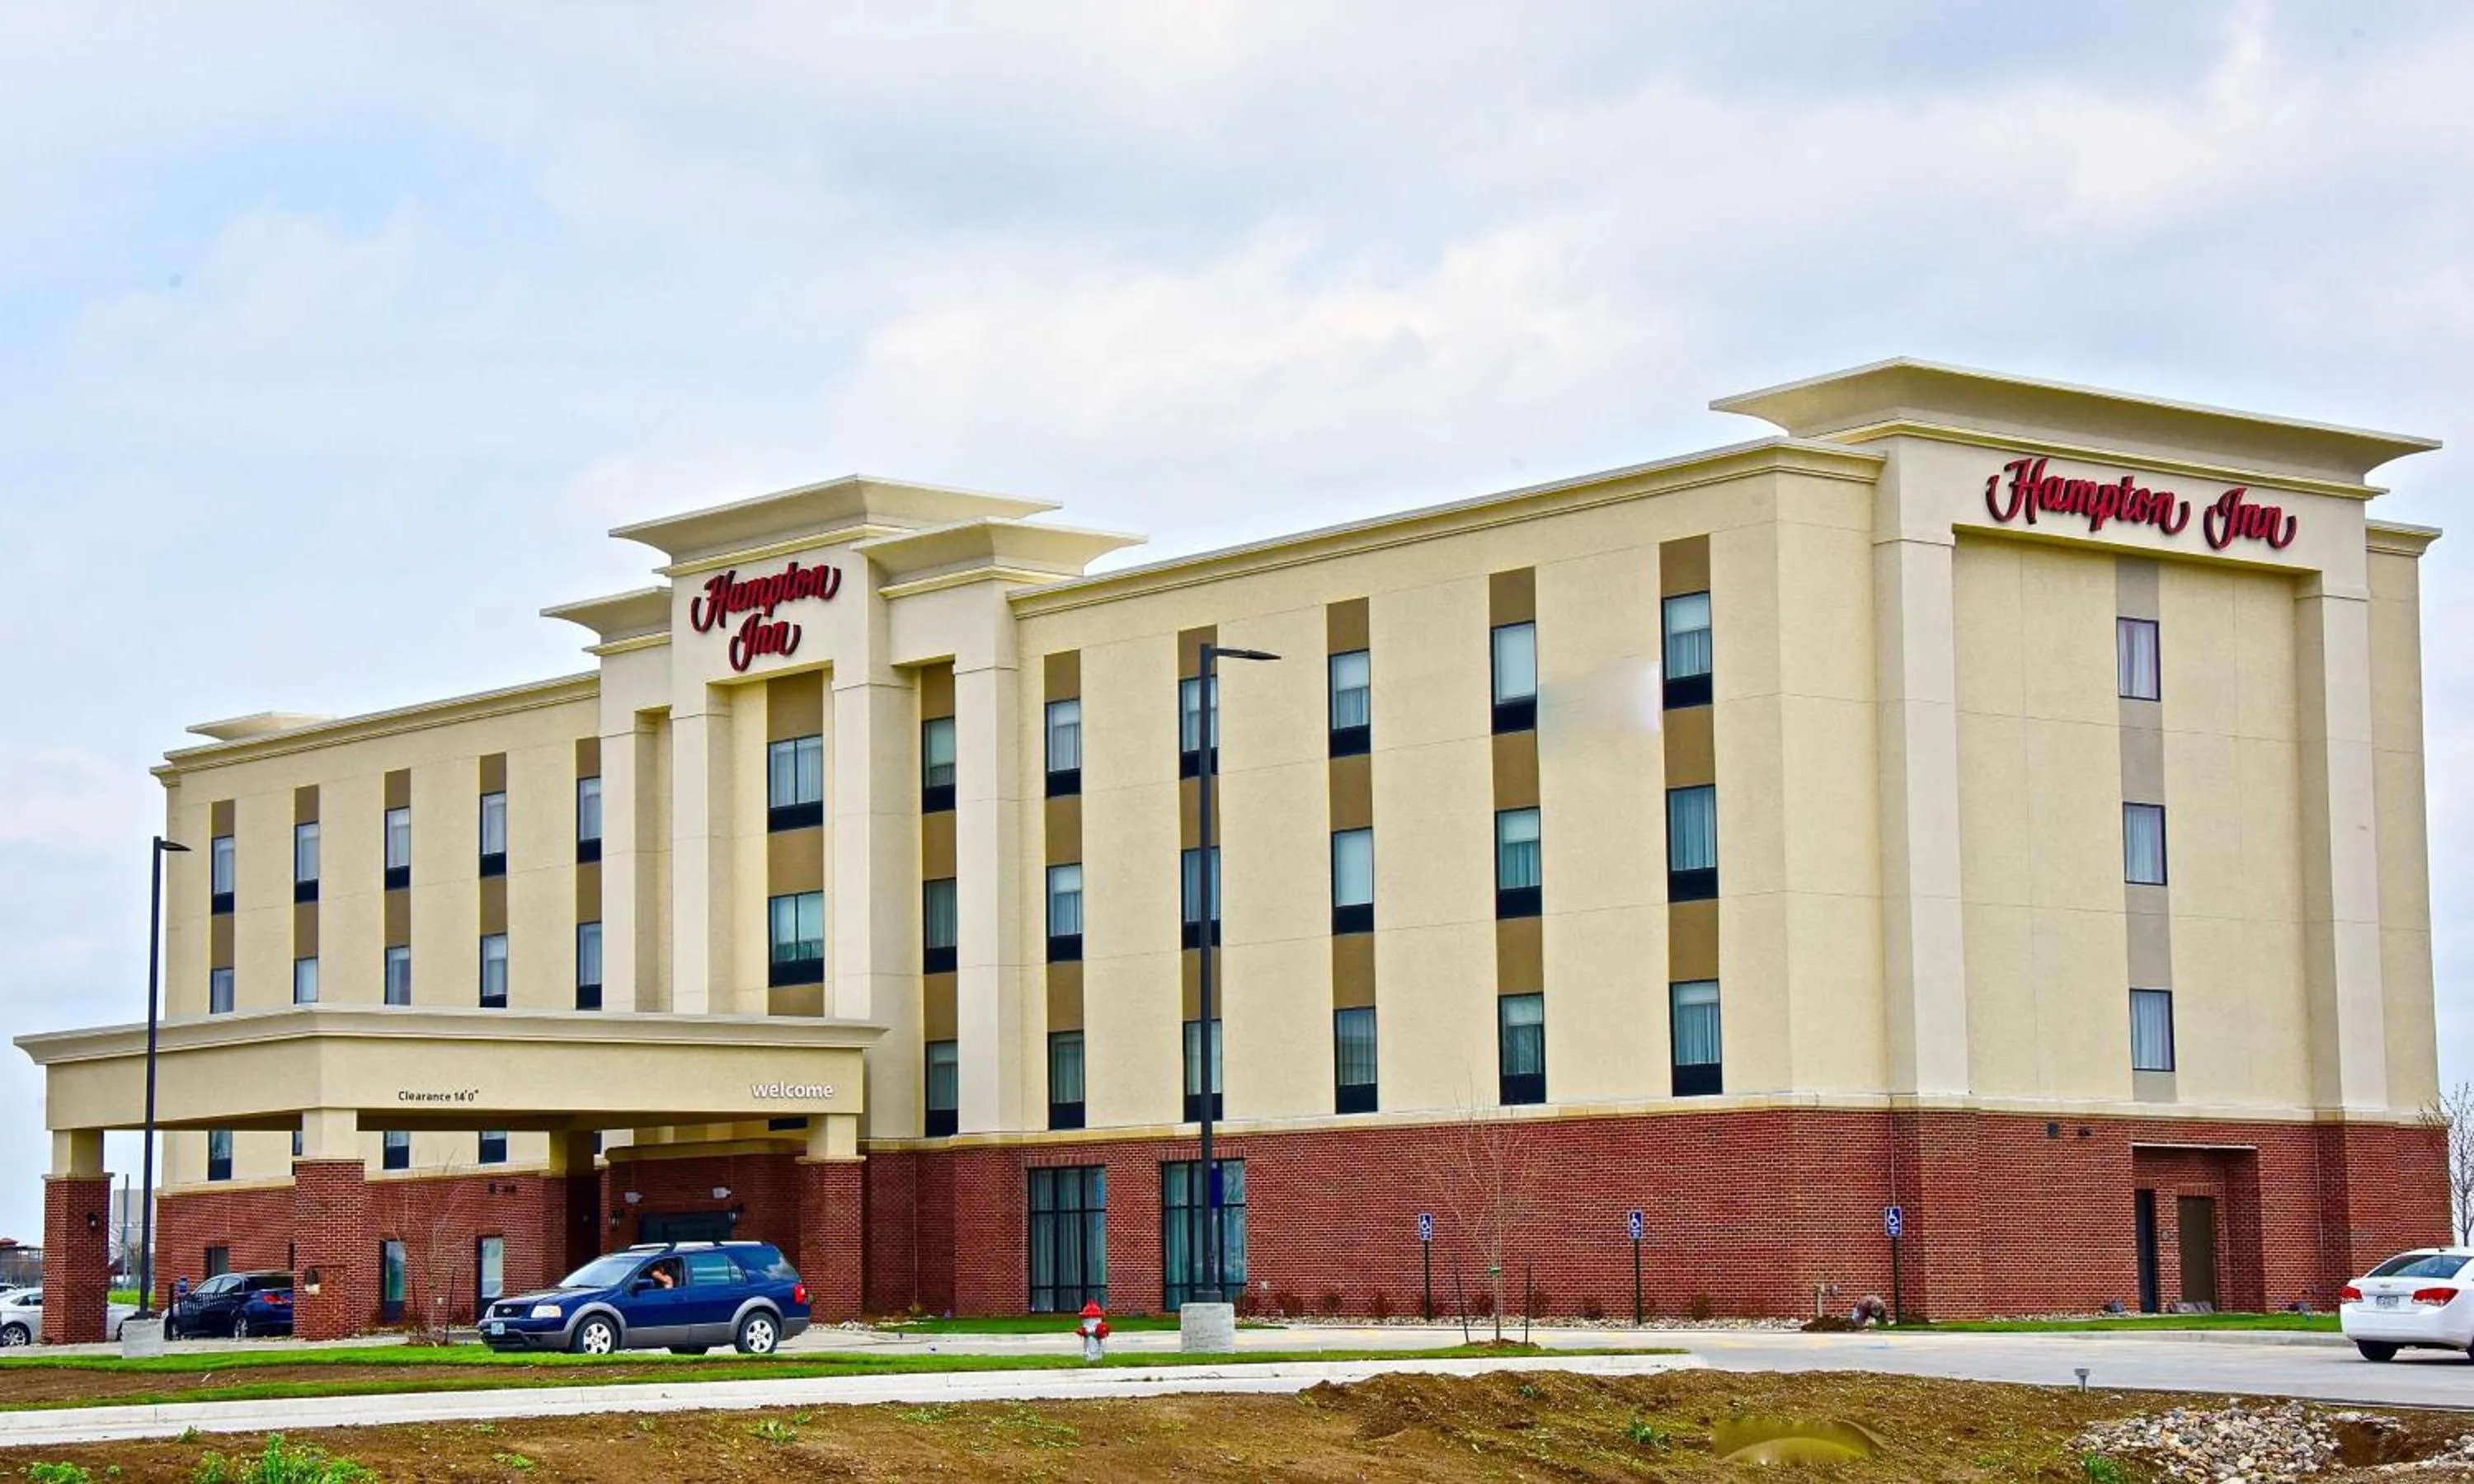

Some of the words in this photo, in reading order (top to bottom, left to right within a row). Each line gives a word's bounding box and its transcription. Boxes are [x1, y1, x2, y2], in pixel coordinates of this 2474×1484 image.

[1986, 457, 2191, 536] Hampton
[2203, 487, 2297, 550] Inn
[691, 562, 841, 632] Hampton
[729, 613, 802, 672] Inn
[398, 1091, 451, 1101] Clearance
[751, 1081, 834, 1098] welcome
